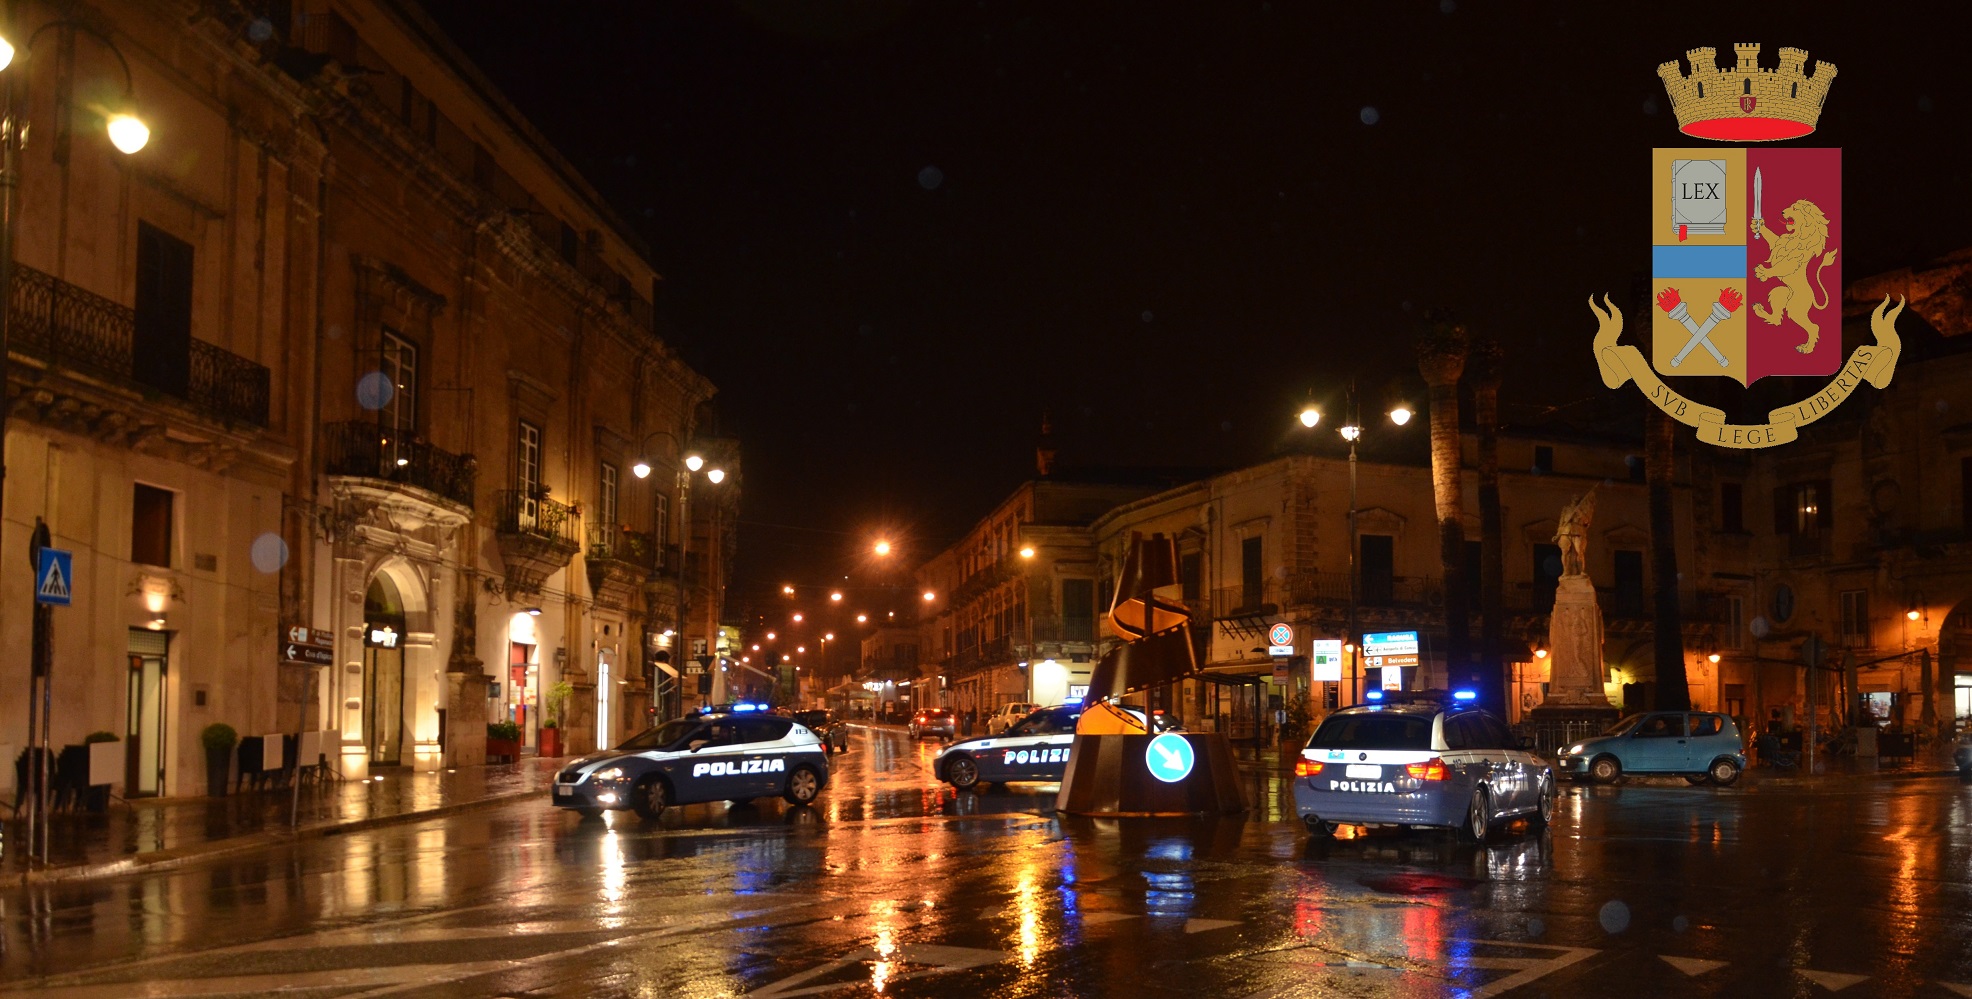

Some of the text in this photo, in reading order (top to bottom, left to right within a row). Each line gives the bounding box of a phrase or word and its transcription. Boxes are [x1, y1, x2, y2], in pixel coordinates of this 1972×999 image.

[1003, 748, 1070, 765] POLIZI
[693, 758, 785, 778] POLIZIA
[1330, 779, 1395, 793] POLIZIA
